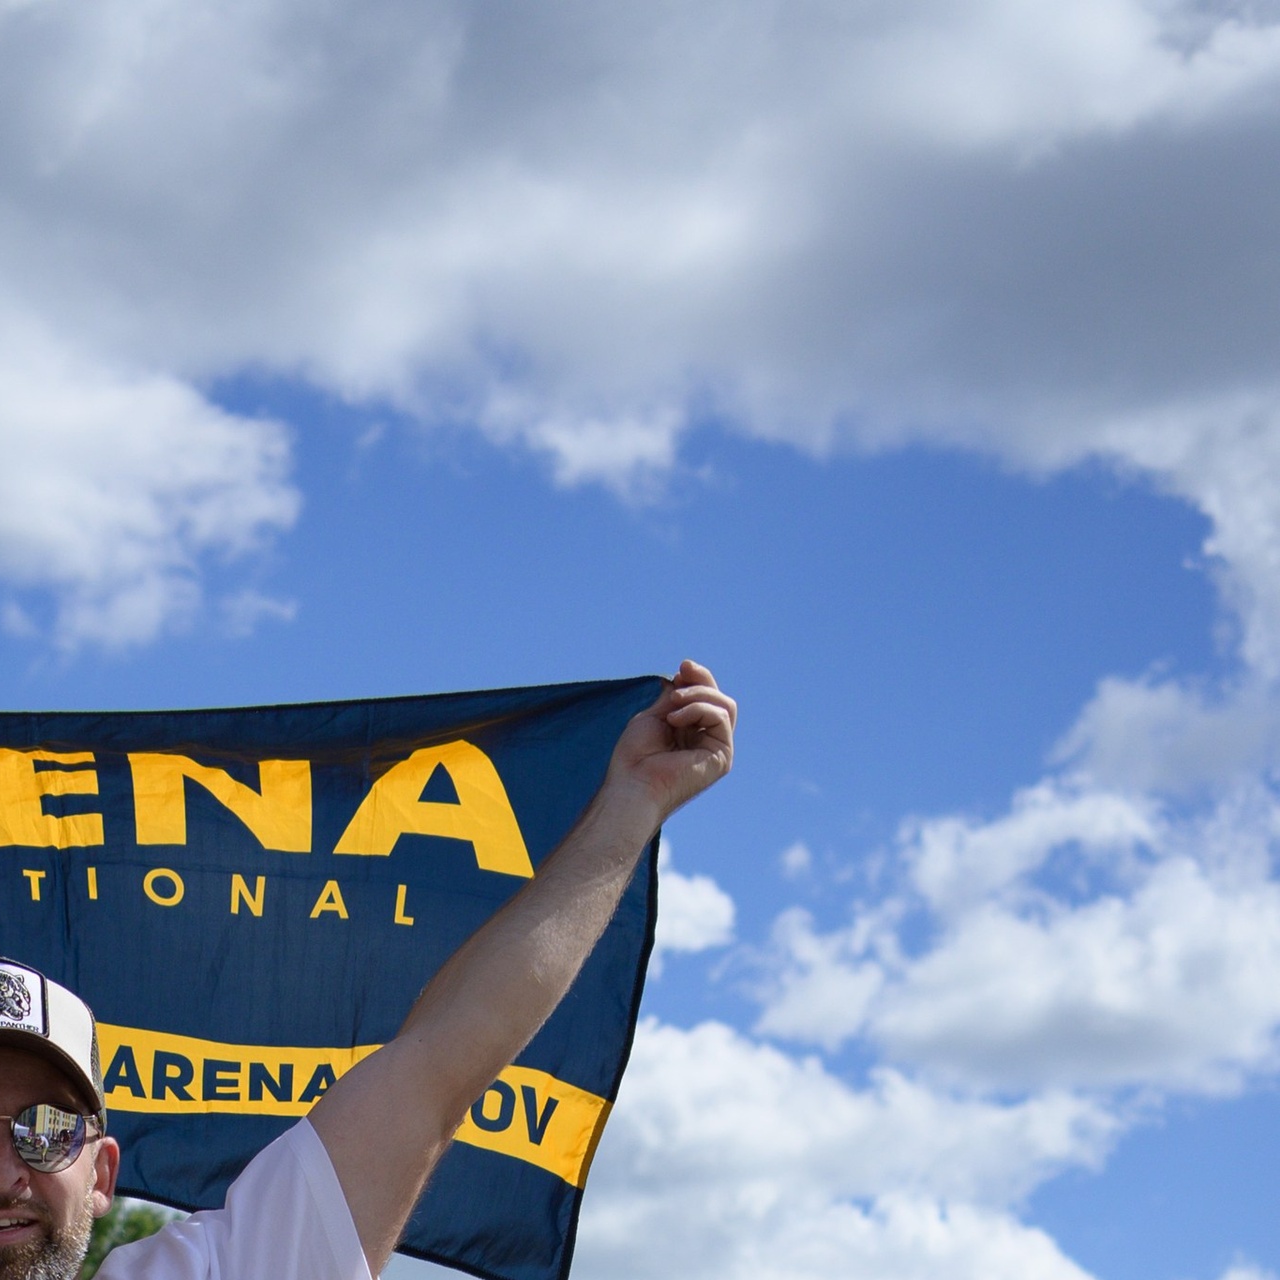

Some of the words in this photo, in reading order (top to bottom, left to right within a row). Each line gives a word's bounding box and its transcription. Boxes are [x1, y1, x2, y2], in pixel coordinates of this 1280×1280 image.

[0, 1021, 39, 1033] PANTHER
[103, 1044, 337, 1103] ARENA
[470, 1078, 560, 1146] OV
